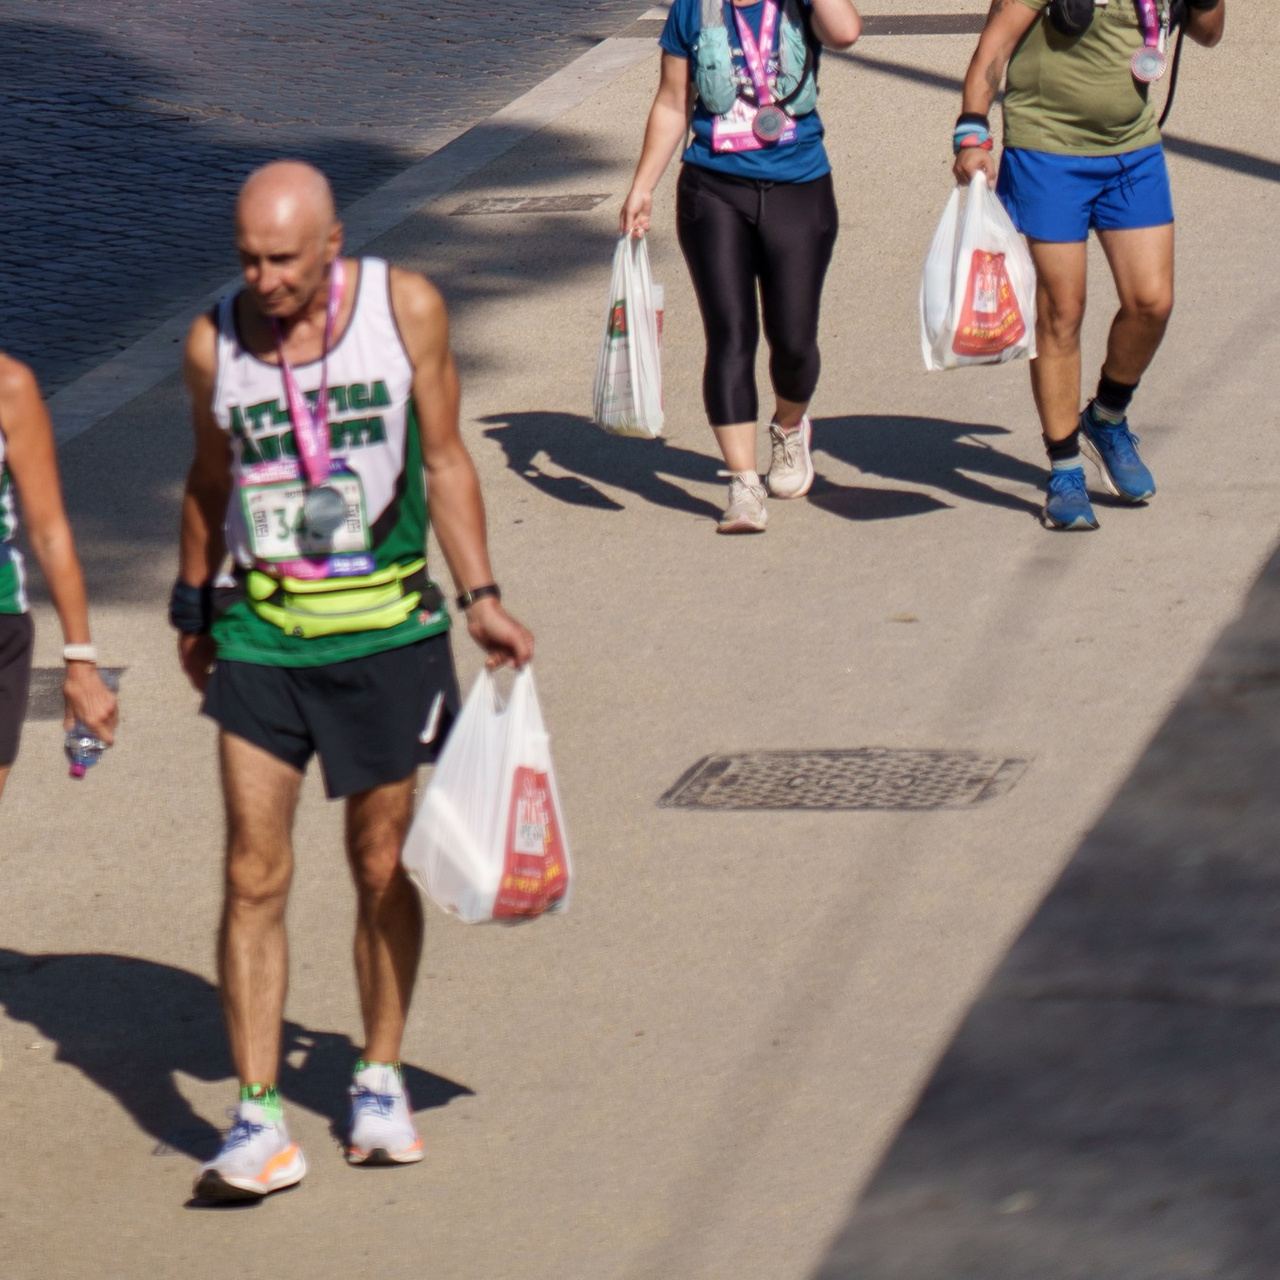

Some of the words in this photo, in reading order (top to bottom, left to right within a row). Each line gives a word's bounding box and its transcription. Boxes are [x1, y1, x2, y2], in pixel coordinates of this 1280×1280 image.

[228, 379, 393, 435] ATLTICA
[240, 415, 388, 465] AUGSTA
[273, 504, 305, 541] 34
